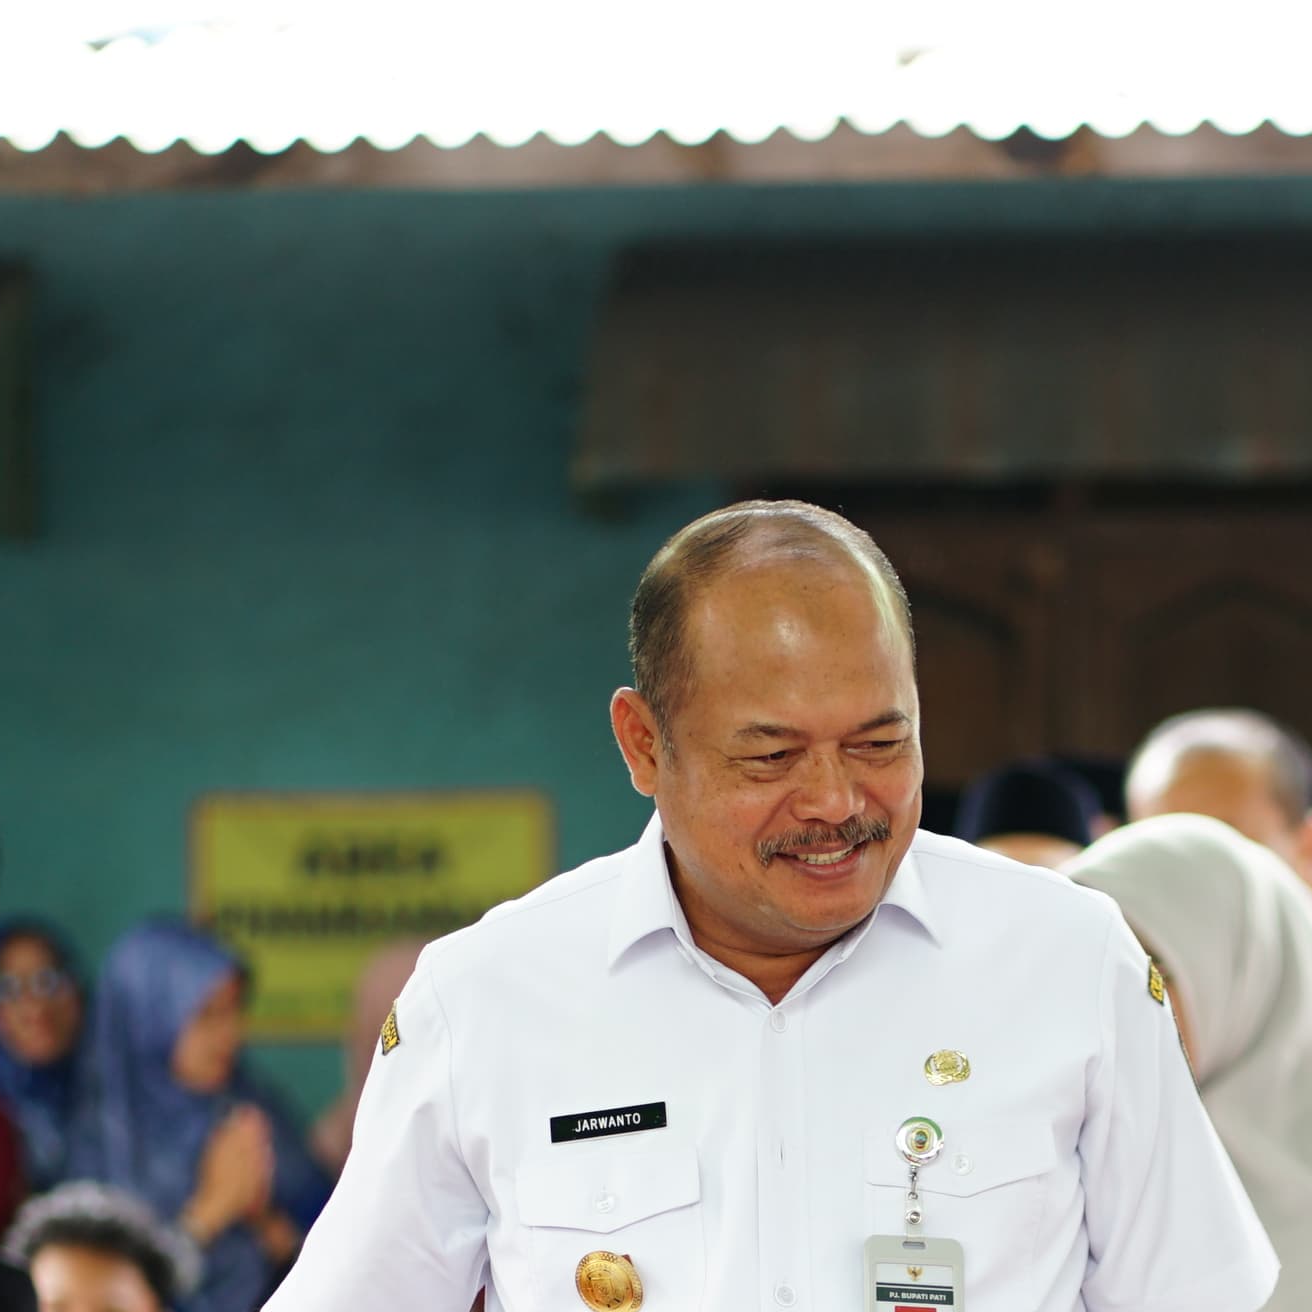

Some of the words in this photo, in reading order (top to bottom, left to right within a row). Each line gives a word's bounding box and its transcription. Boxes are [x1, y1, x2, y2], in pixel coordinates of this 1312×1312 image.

[574, 1112, 641, 1133] JARWANTO
[901, 1291, 928, 1301] BUPATI
[929, 1293, 947, 1301] PATI
